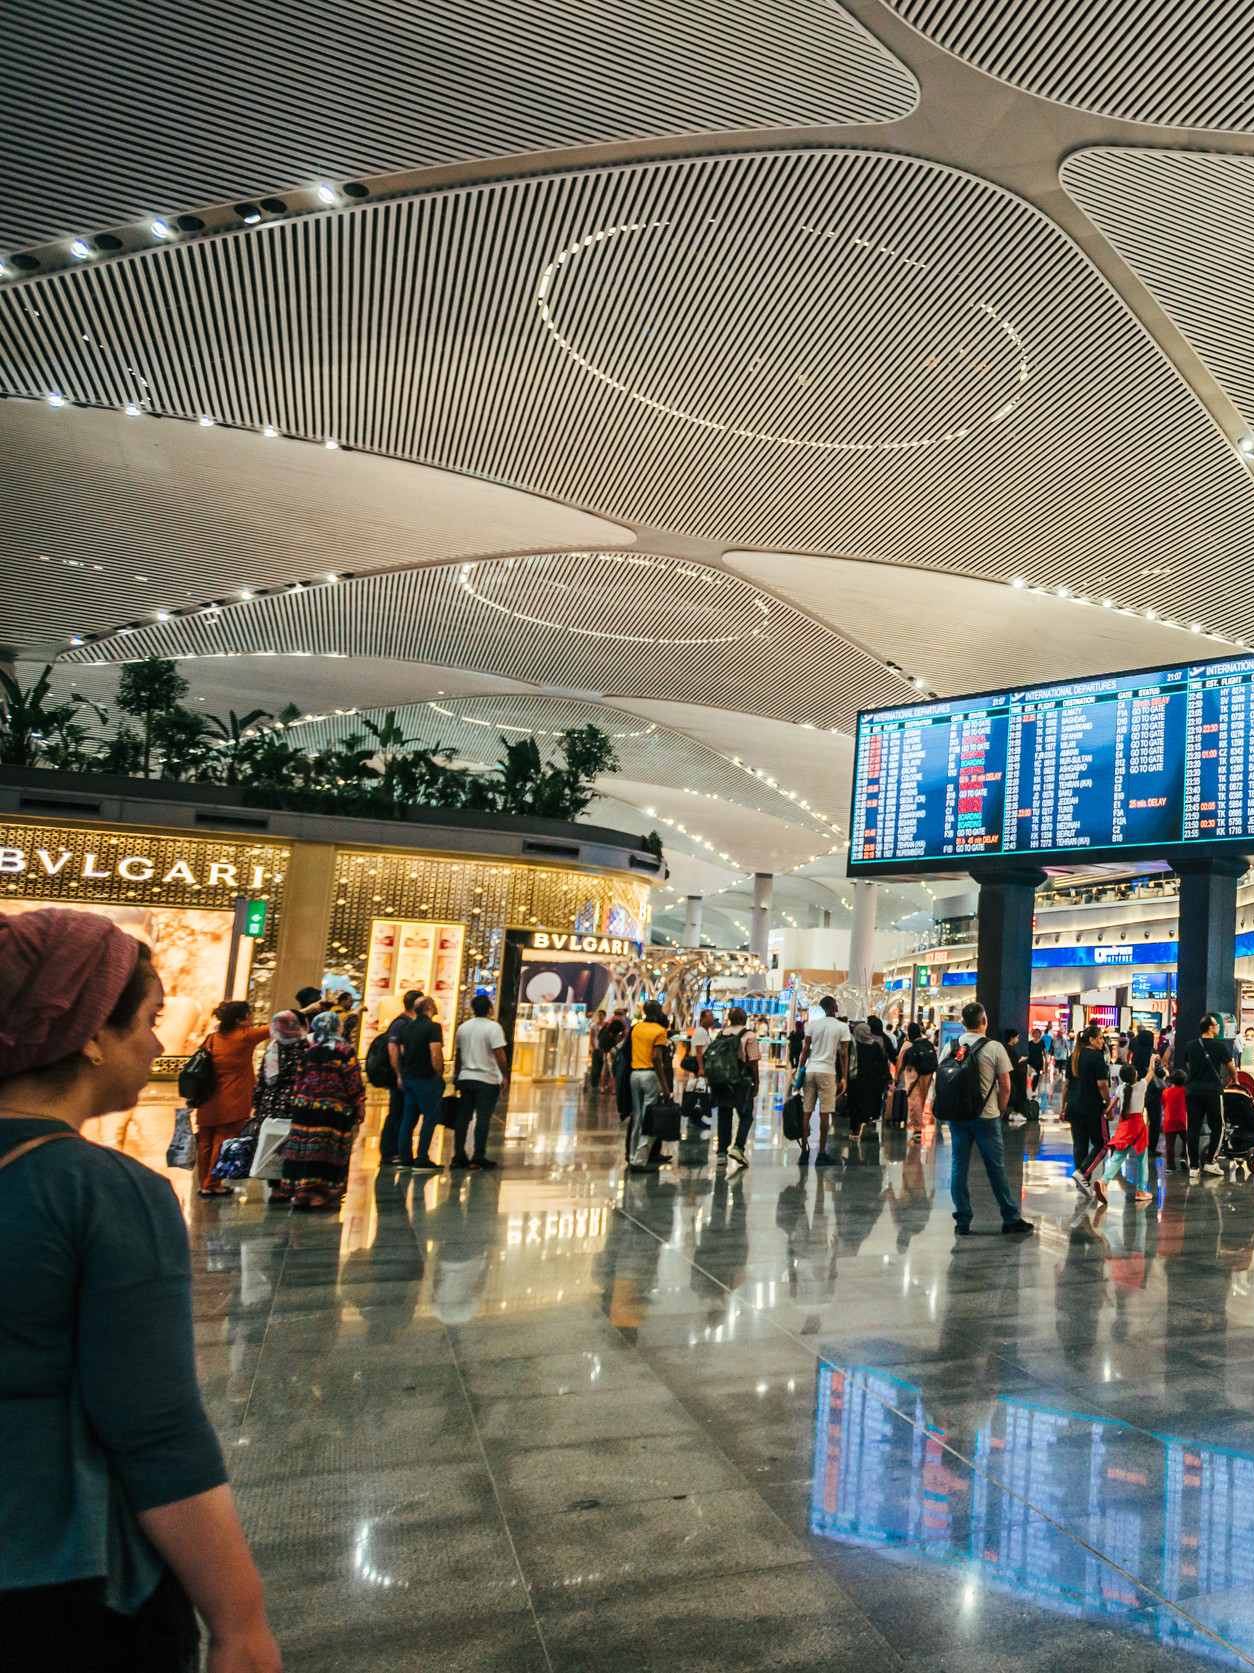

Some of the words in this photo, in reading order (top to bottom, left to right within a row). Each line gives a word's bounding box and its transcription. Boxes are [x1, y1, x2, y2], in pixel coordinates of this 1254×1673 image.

[1025, 688, 1072, 701] INTERNATIONAL
[1073, 681, 1116, 694] DEPARTURES
[1166, 671, 1182, 681] 21:07
[1189, 681, 1202, 689] TIME
[1221, 676, 1242, 685] FLIGHT
[1117, 690, 1132, 699] GATE
[1138, 687, 1160, 696] STATUS
[1220, 688, 1228, 696] HY
[1220, 696, 1228, 705] SV
[873, 711, 913, 722] INTERNATIONAL
[913, 705, 949, 717] DEPARTURES
[1132, 707, 1140, 715] GO
[1141, 706, 1149, 714] TO
[1150, 704, 1165, 713] GATE
[1219, 705, 1228, 713] TK
[1219, 714, 1228, 722] PS
[1202, 723, 1218, 732] 23:30
[1130, 749, 1139, 757] GO
[1140, 748, 1147, 756] TO
[1149, 746, 1163, 755] GATE
[1201, 749, 1217, 758] 01:00
[1218, 748, 1227, 756] CZ
[1130, 757, 1138, 765] GO
[1139, 756, 1147, 764] TO
[1148, 755, 1163, 763] GATE
[1218, 757, 1226, 765] TK
[1148, 763, 1163, 771] GATE
[1218, 774, 1226, 782] TK
[1217, 783, 1226, 791] TK
[1217, 792, 1226, 800] TK
[1148, 797, 1166, 805] DELAY
[1200, 801, 1216, 810] 00:05
[1217, 801, 1225, 809] TK
[1199, 819, 1215, 827] 00:30
[1216, 818, 1225, 826] TK
[0, 846, 266, 888] BVLGARI
[533, 932, 630, 955] BVLGARI
